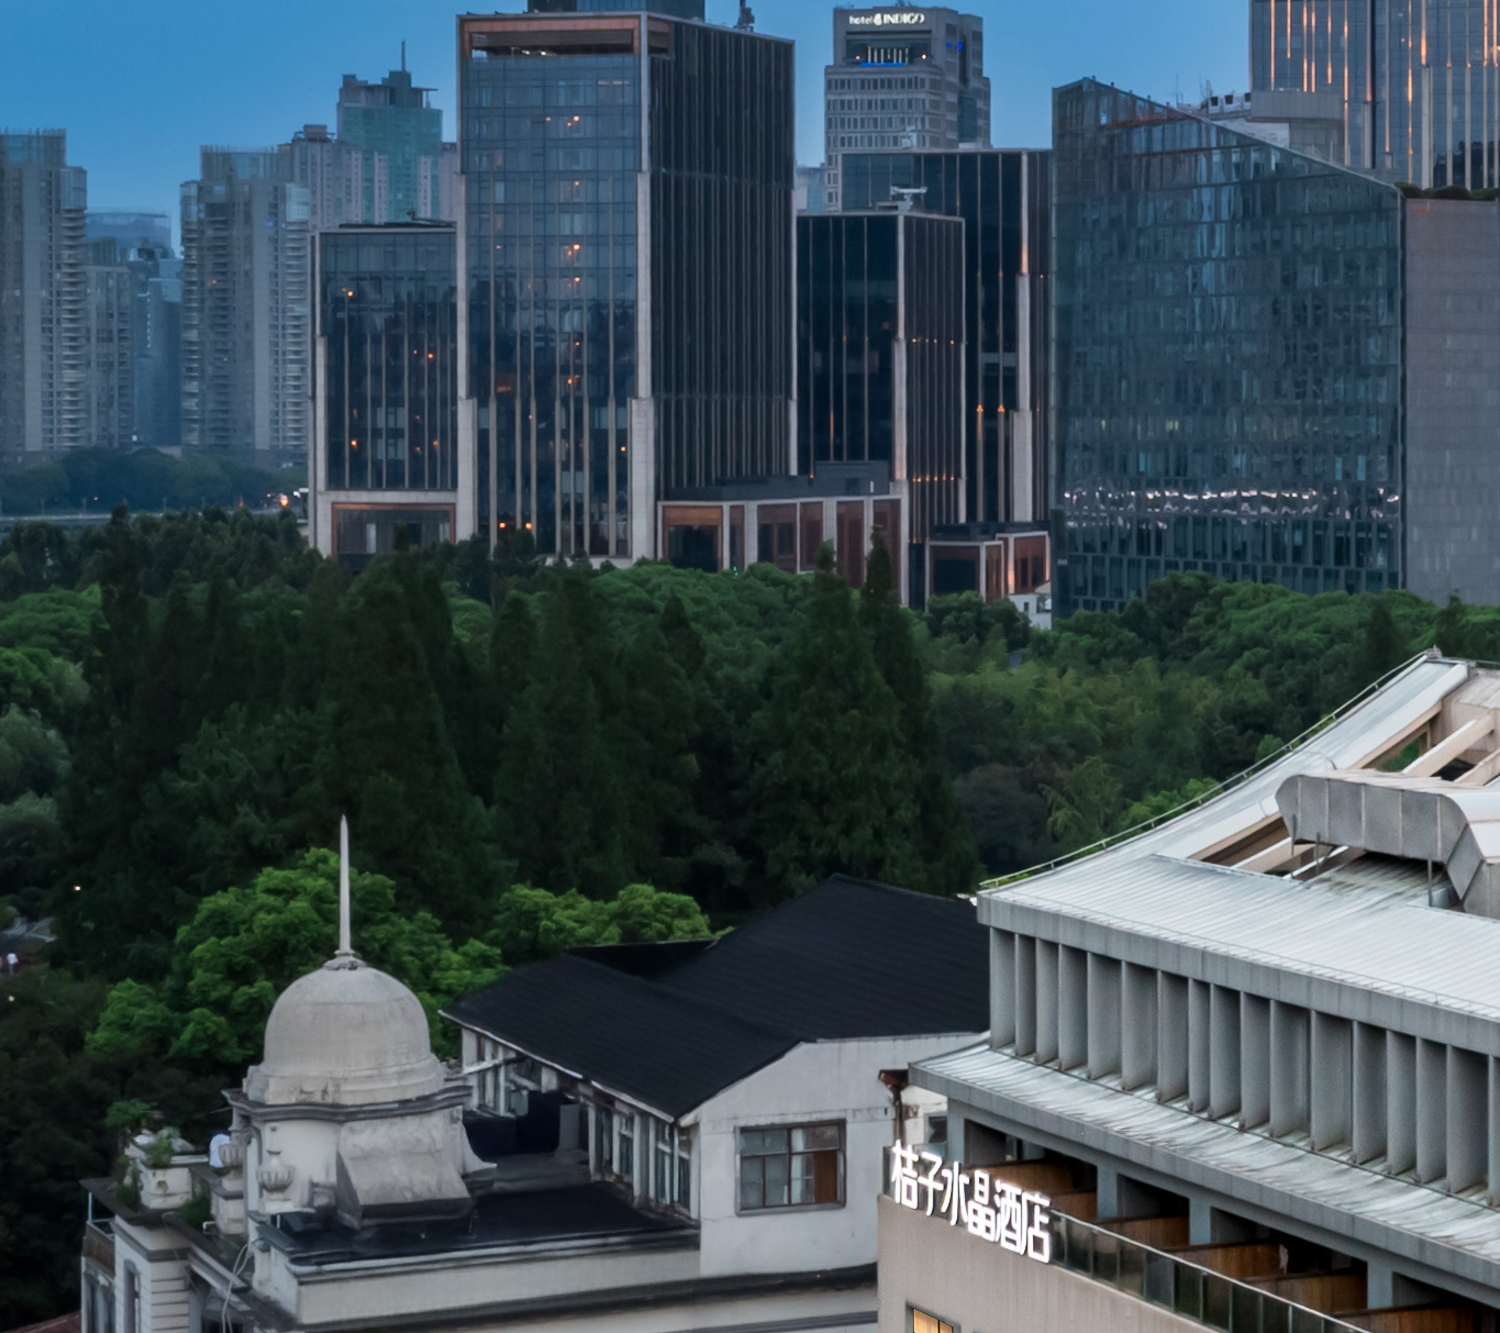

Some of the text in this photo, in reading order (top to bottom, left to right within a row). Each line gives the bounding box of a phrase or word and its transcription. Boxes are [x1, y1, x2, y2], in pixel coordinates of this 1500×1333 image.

[848, 12, 925, 25] hotel INDIGO
[891, 1139, 1053, 1264] 桔子水晶酒店
